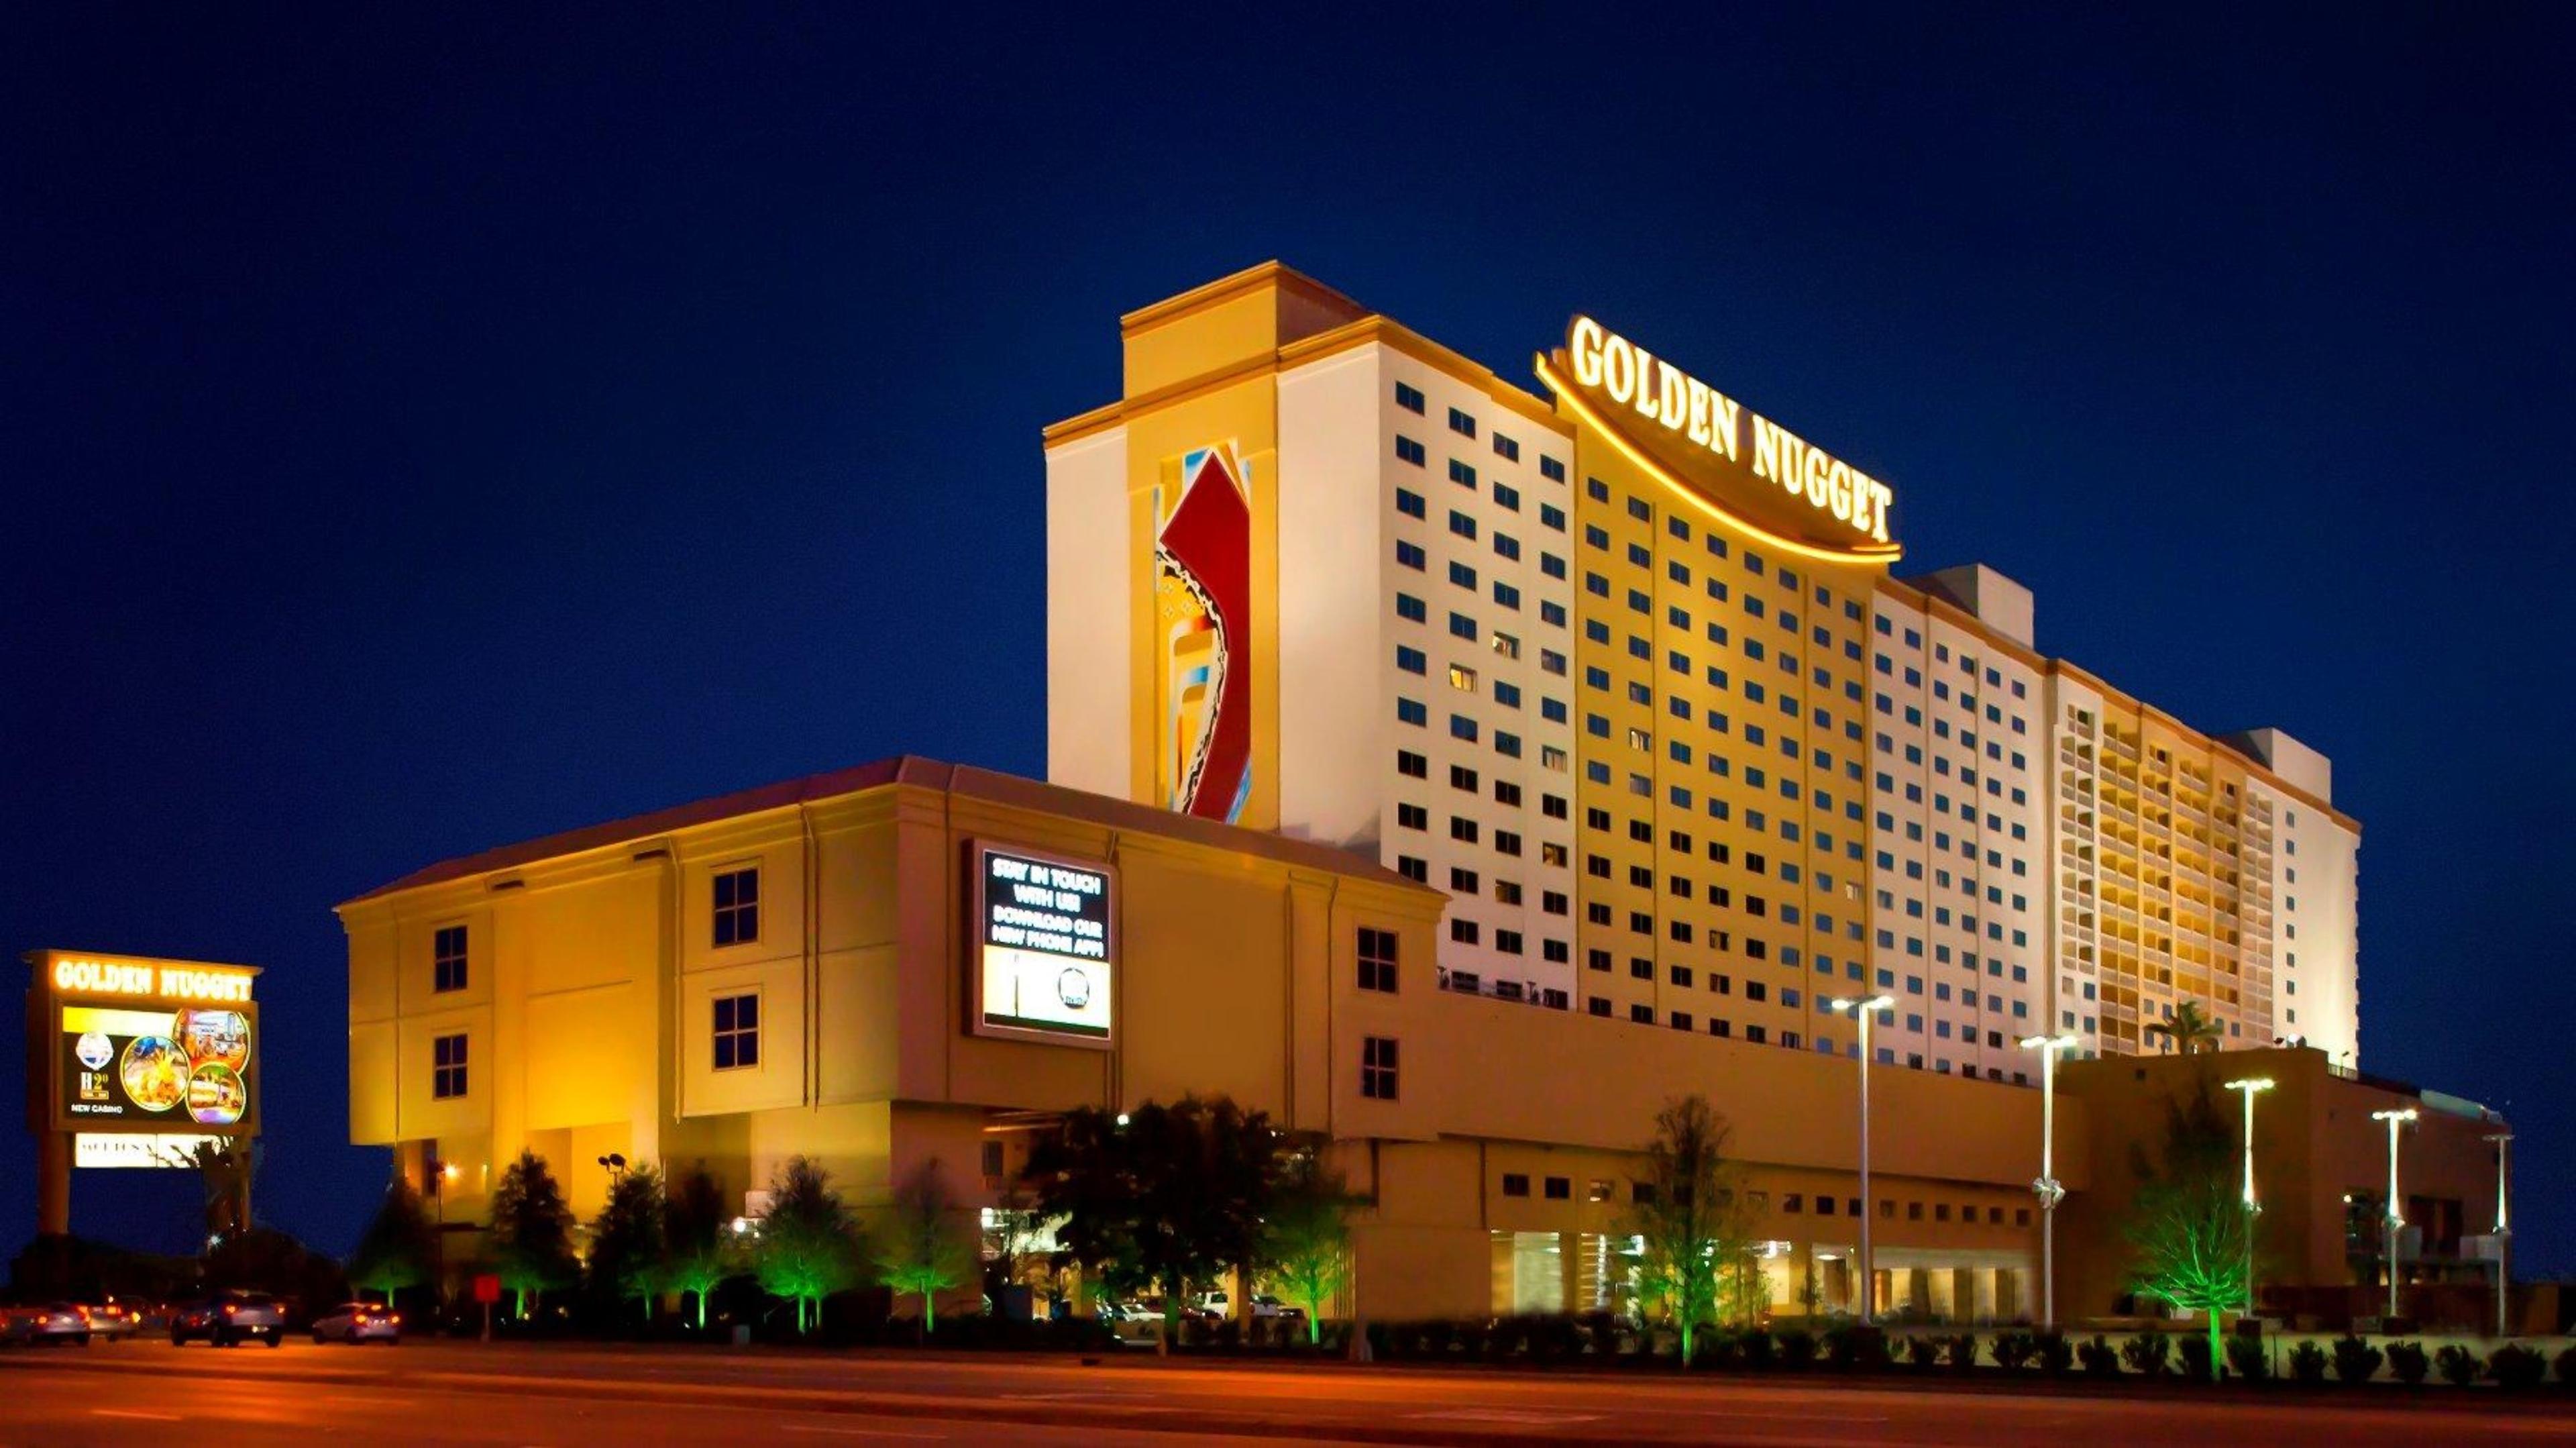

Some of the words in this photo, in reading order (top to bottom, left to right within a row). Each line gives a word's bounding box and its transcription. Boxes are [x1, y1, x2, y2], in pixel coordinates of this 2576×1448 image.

[1572, 315, 1740, 462] GOLDEN
[1752, 414, 1892, 543] NUGGET
[993, 858, 1029, 880] STAY
[1031, 865, 1049, 885] IN
[1051, 868, 1101, 894] TOUCH
[1014, 884, 1054, 907] WITH
[992, 925, 1026, 945] NEW
[1027, 931, 1073, 953] PHONE
[993, 904, 1073, 932] DOWNLOAD
[1074, 919, 1103, 939] OUR
[56, 960, 152, 994] GOLDEN
[161, 970, 253, 1000] NUGGET
[71, 1104, 91, 1113] NEW
[91, 1104, 123, 1115] CASINO
